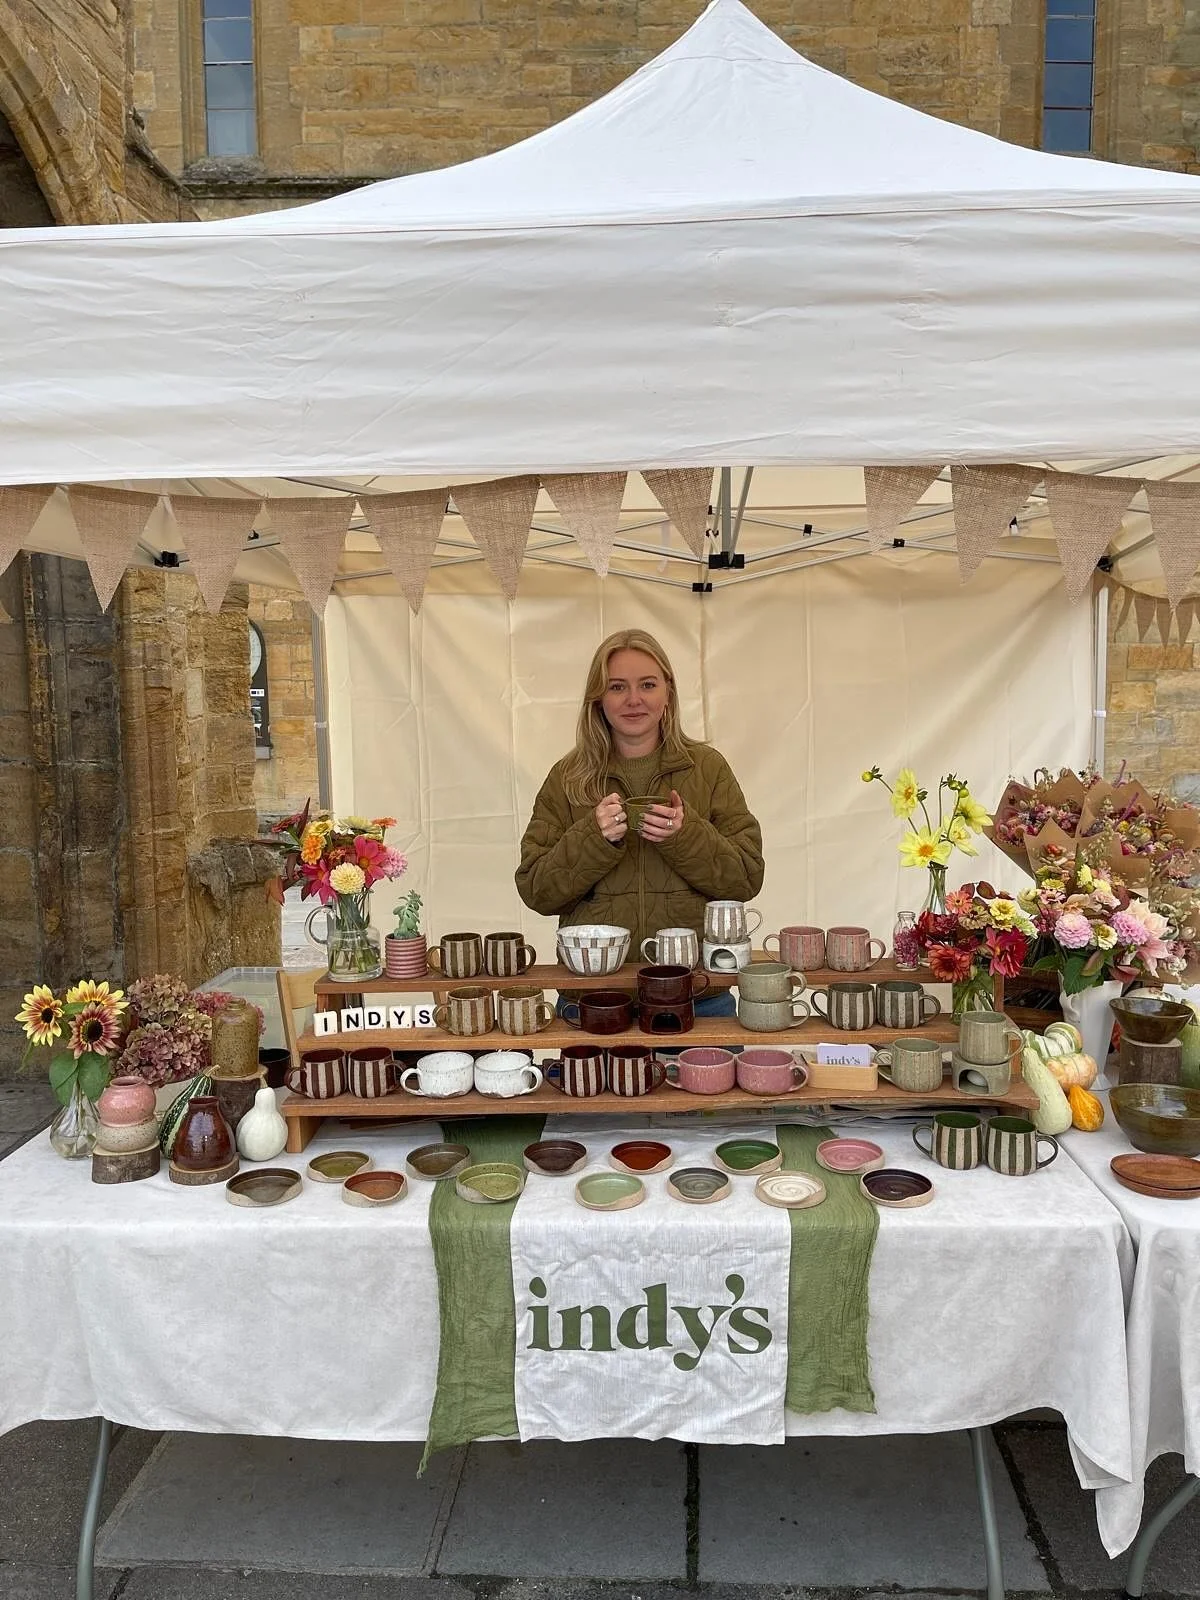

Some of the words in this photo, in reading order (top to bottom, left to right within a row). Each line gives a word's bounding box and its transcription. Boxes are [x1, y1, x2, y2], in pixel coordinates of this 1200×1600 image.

[323, 1009, 430, 1032] INDYS
[826, 1056, 861, 1065] indy's
[527, 1273, 773, 1371] indy's
